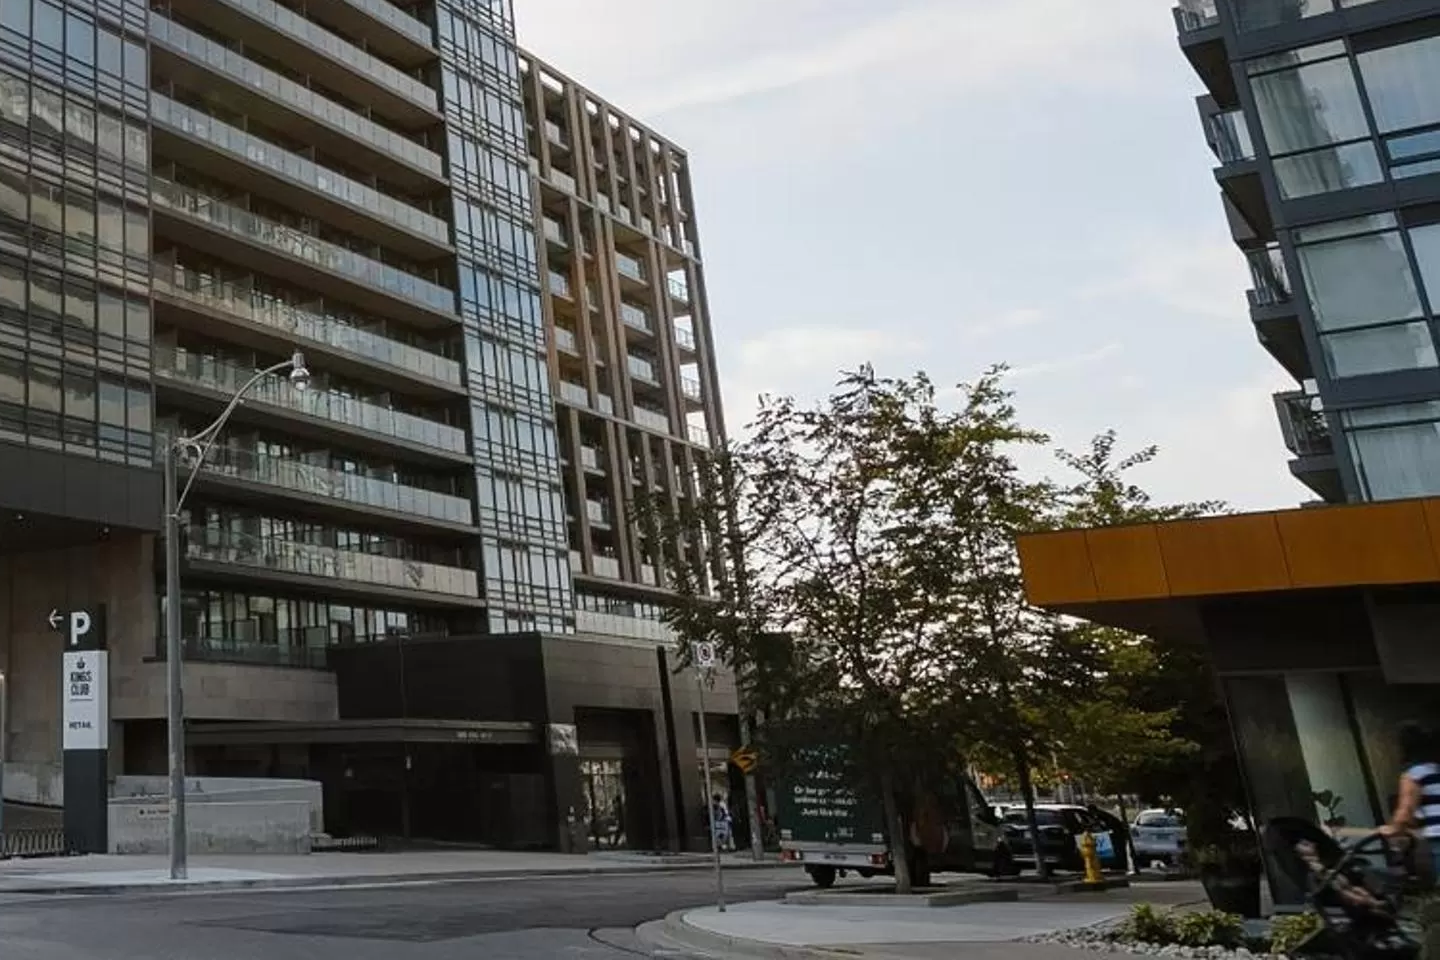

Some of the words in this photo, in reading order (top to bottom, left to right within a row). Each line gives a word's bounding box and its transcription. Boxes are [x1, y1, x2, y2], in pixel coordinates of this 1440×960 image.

[70, 611, 91, 646] P
[70, 671, 92, 683] KINGS
[70, 683, 90, 696] CLUB
